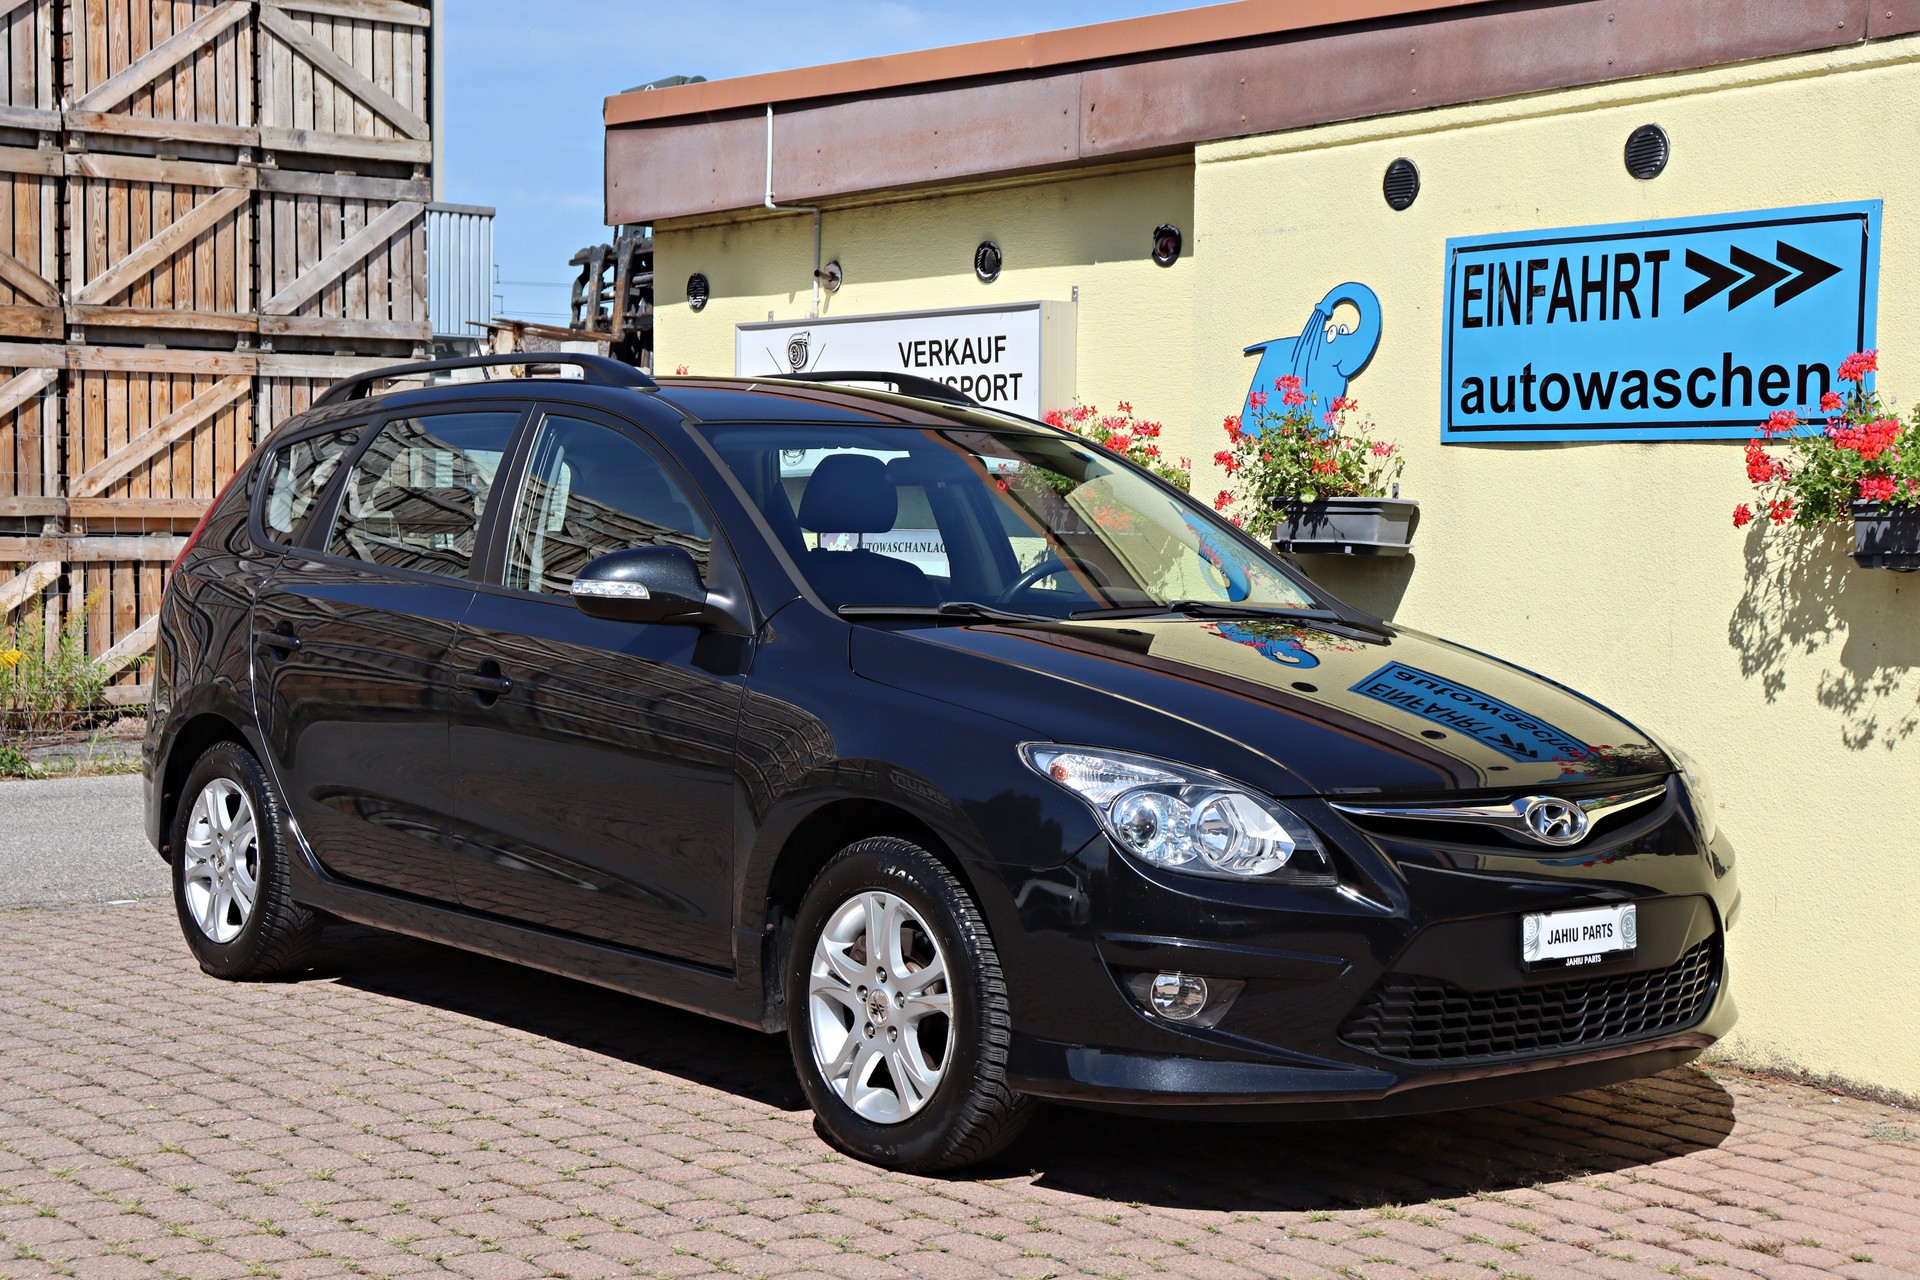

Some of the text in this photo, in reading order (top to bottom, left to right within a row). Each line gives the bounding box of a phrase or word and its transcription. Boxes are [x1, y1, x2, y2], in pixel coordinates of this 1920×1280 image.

[1461, 249, 1670, 329] EINFAHRT
[898, 335, 1007, 368] VERKAUF
[1459, 352, 1831, 415] autowaschen
[1547, 923, 1613, 945] JAHIU PARTS
[1565, 954, 1602, 967] JAHIU PARTS
